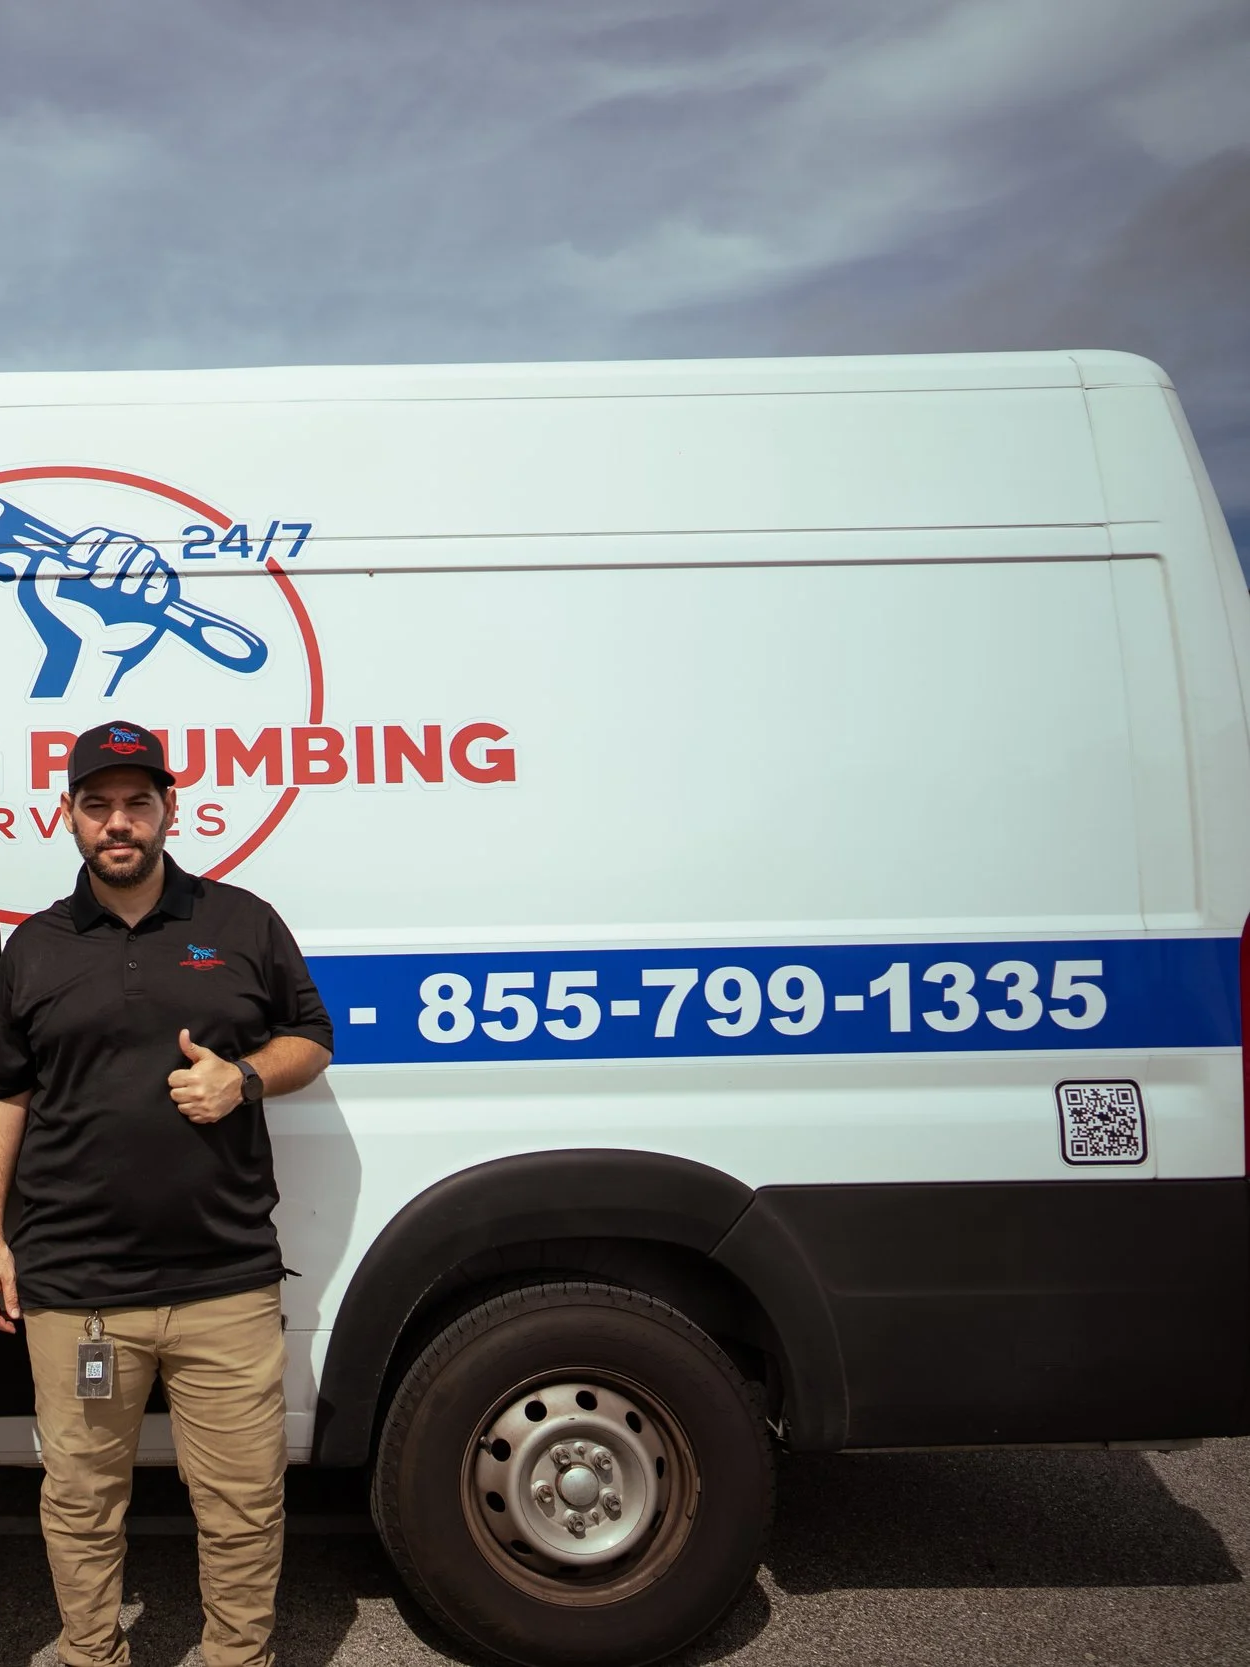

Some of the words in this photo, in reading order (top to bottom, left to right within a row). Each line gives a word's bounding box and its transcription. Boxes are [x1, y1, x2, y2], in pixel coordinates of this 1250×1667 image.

[181, 520, 313, 563] 24/7
[31, 722, 516, 789] PUMBING
[418, 960, 1107, 1044] 855-799-1335
